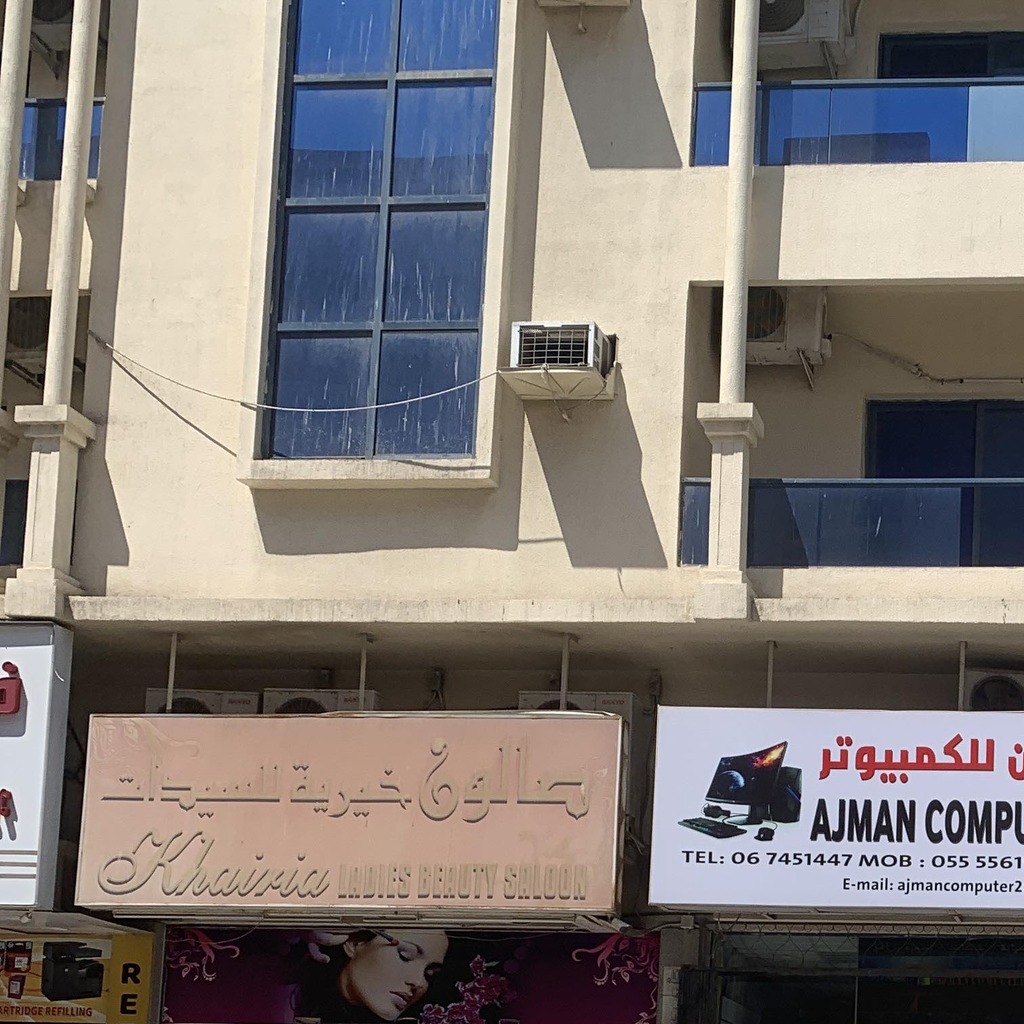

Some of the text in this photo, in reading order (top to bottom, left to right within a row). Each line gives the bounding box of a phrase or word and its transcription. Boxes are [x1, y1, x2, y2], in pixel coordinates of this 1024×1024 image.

[101, 736, 589, 823] صالون خيرية للسيدات
[818, 733, 995, 784] للكمبيوتر
[809, 798, 916, 843] AJMAN
[98, 831, 588, 901] Khairia LADIES BEAUTY SALOON
[681, 850, 725, 865] TEL:
[731, 851, 760, 865] 06
[767, 852, 853, 867] 7451447
[858, 854, 912, 868] MOB
[931, 855, 969, 869] 055
[842, 878, 894, 892] E-mail:
[45, 1006, 93, 1017] REFILLING
